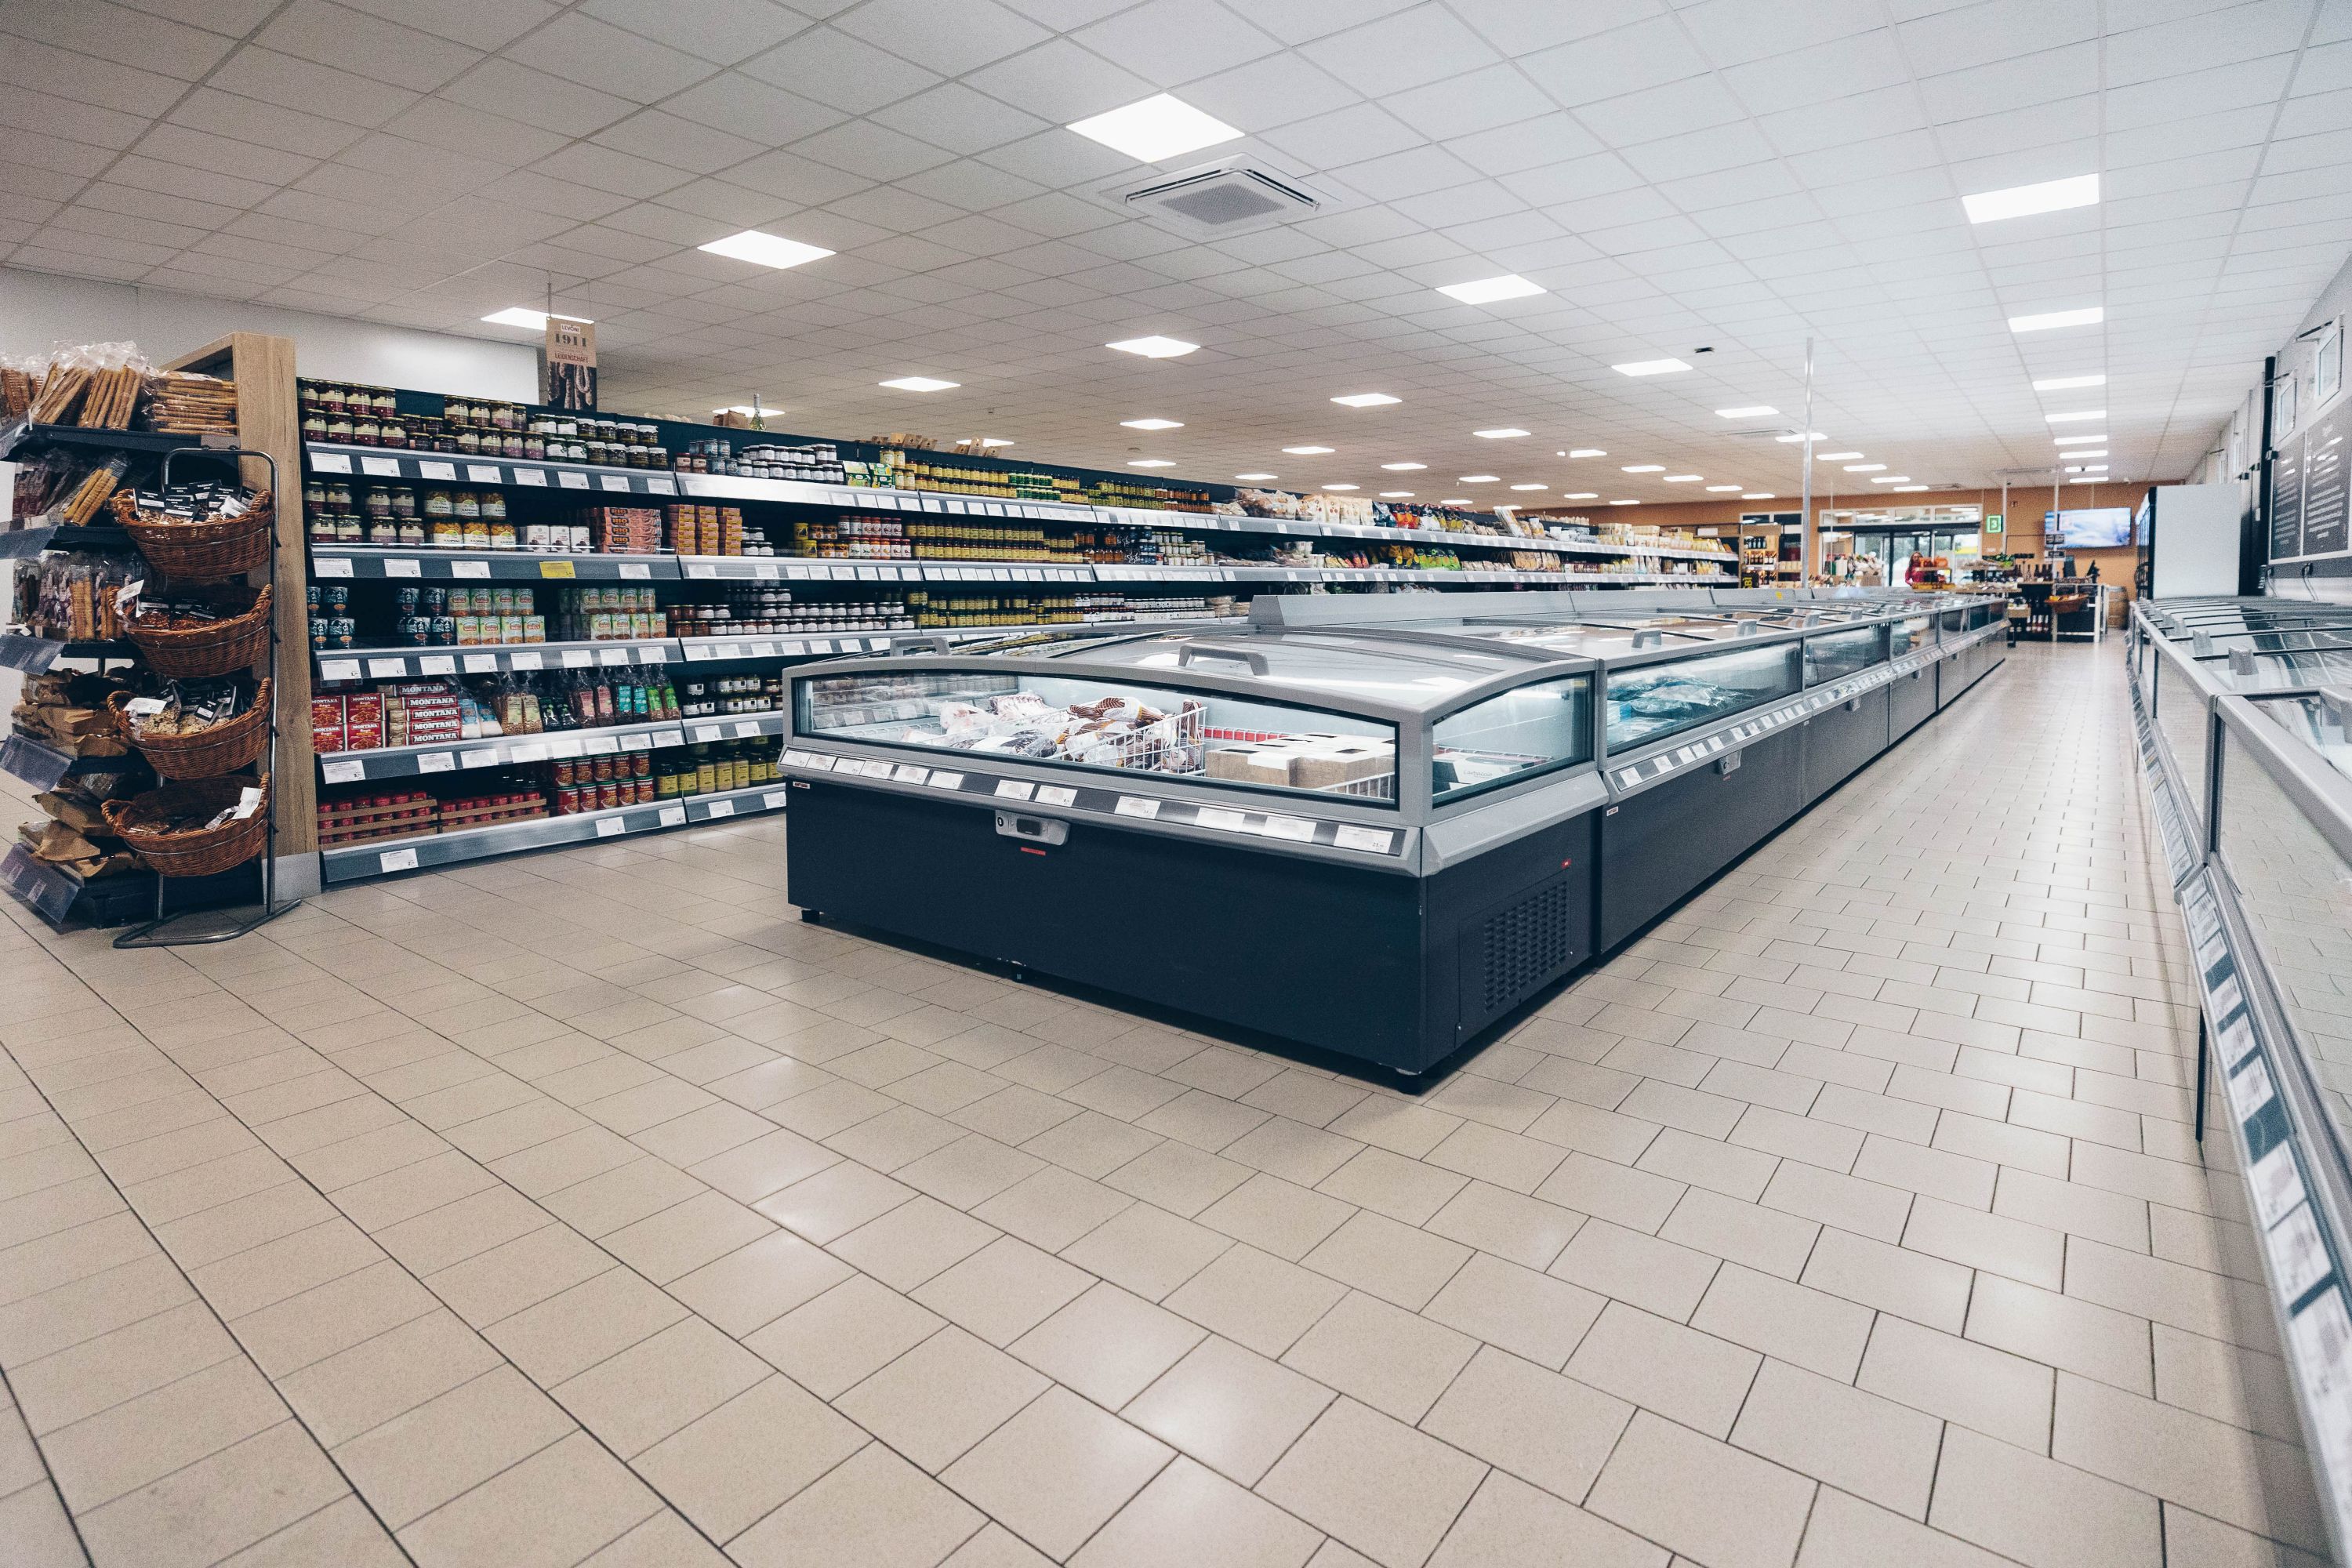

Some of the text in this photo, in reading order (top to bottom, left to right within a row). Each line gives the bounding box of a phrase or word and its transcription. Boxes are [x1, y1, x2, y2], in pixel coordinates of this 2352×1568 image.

[554, 333, 587, 347] 1911
[1991, 520, 1998, 528] 3
[409, 697, 455, 706] MONTANA
[414, 709, 458, 718] MONTANA
[414, 720, 458, 730] MONTANA
[414, 732, 457, 742] MONTANA
